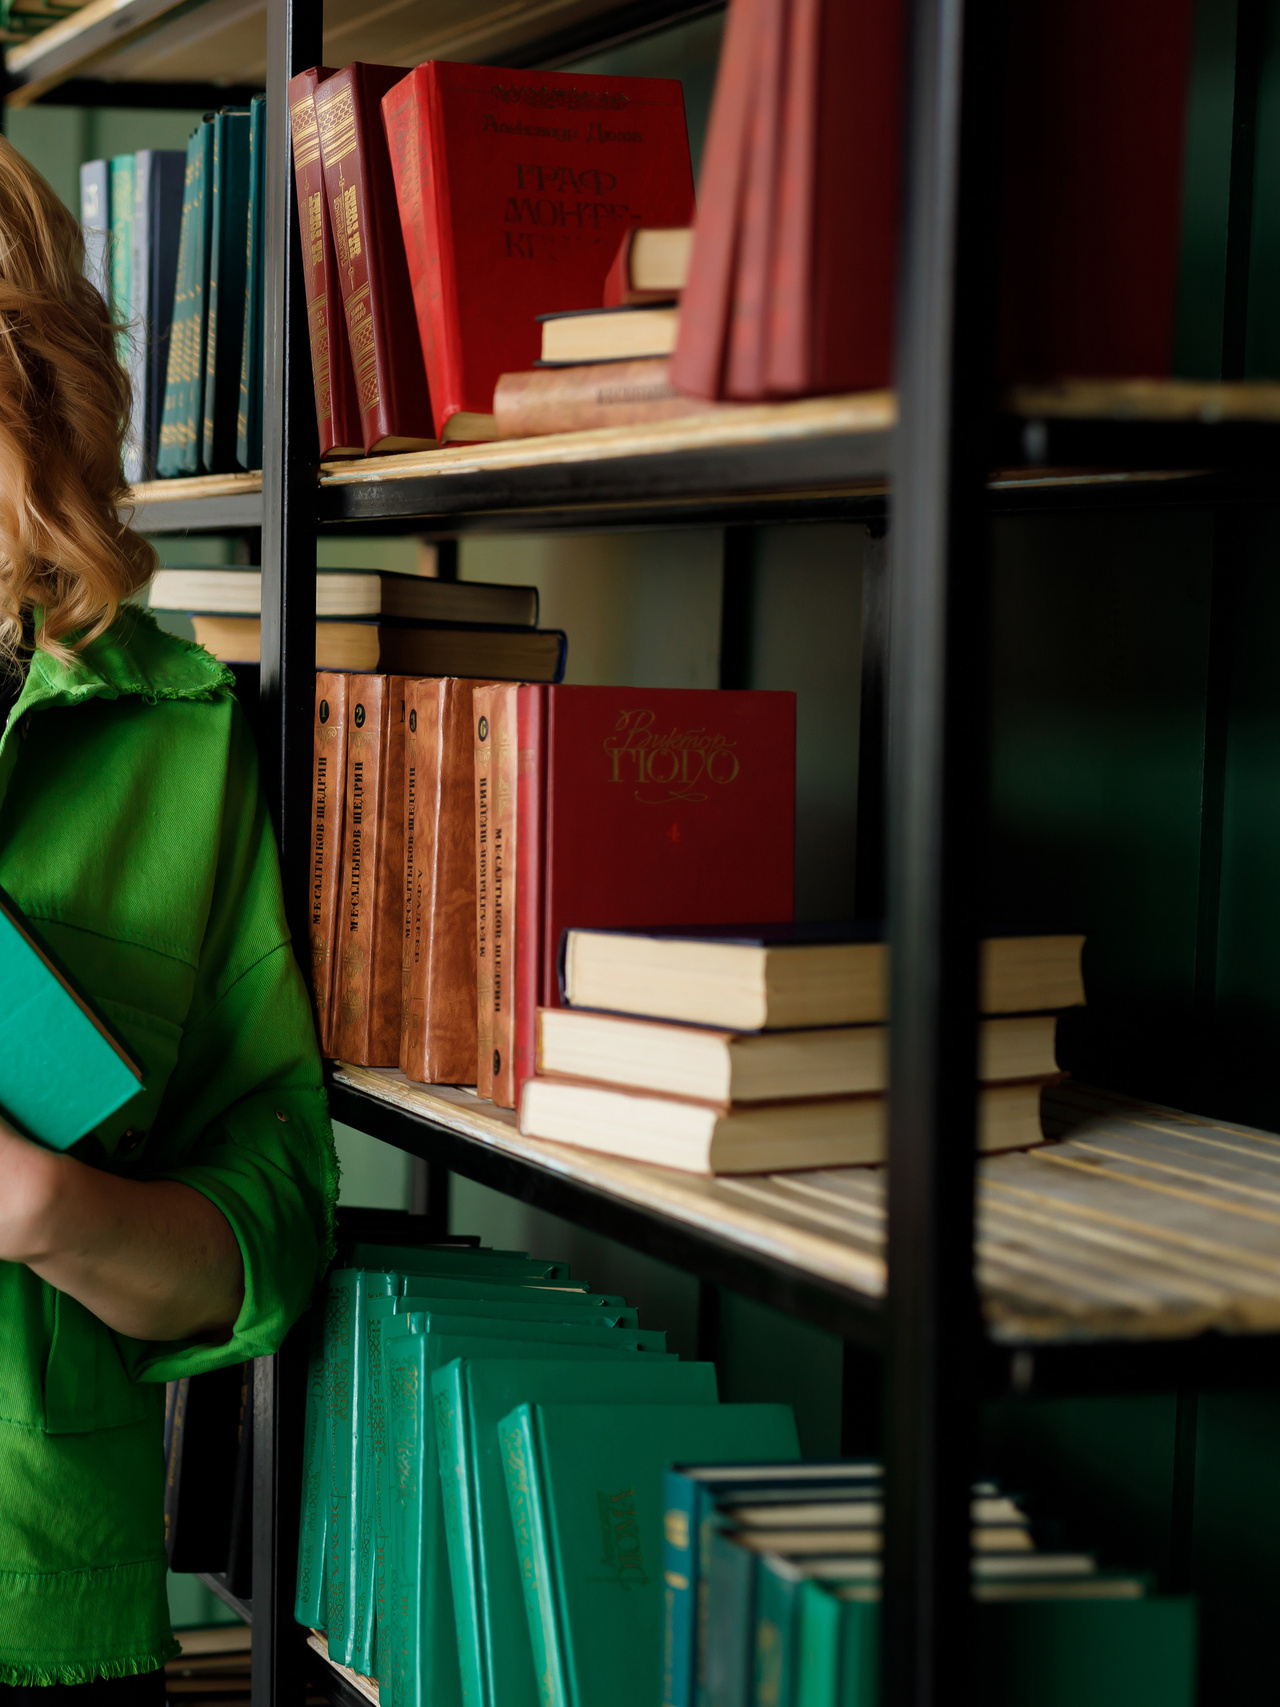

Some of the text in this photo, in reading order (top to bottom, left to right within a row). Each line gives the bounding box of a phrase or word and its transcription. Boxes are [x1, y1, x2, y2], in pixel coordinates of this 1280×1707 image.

[514, 163, 618, 195] ГРАФ
[320, 701, 326, 718] 1
[356, 706, 363, 724] 2
[603, 708, 737, 753] Виктор
[608, 747, 740, 794] ГЮГО
[666, 822, 681, 843] 4
